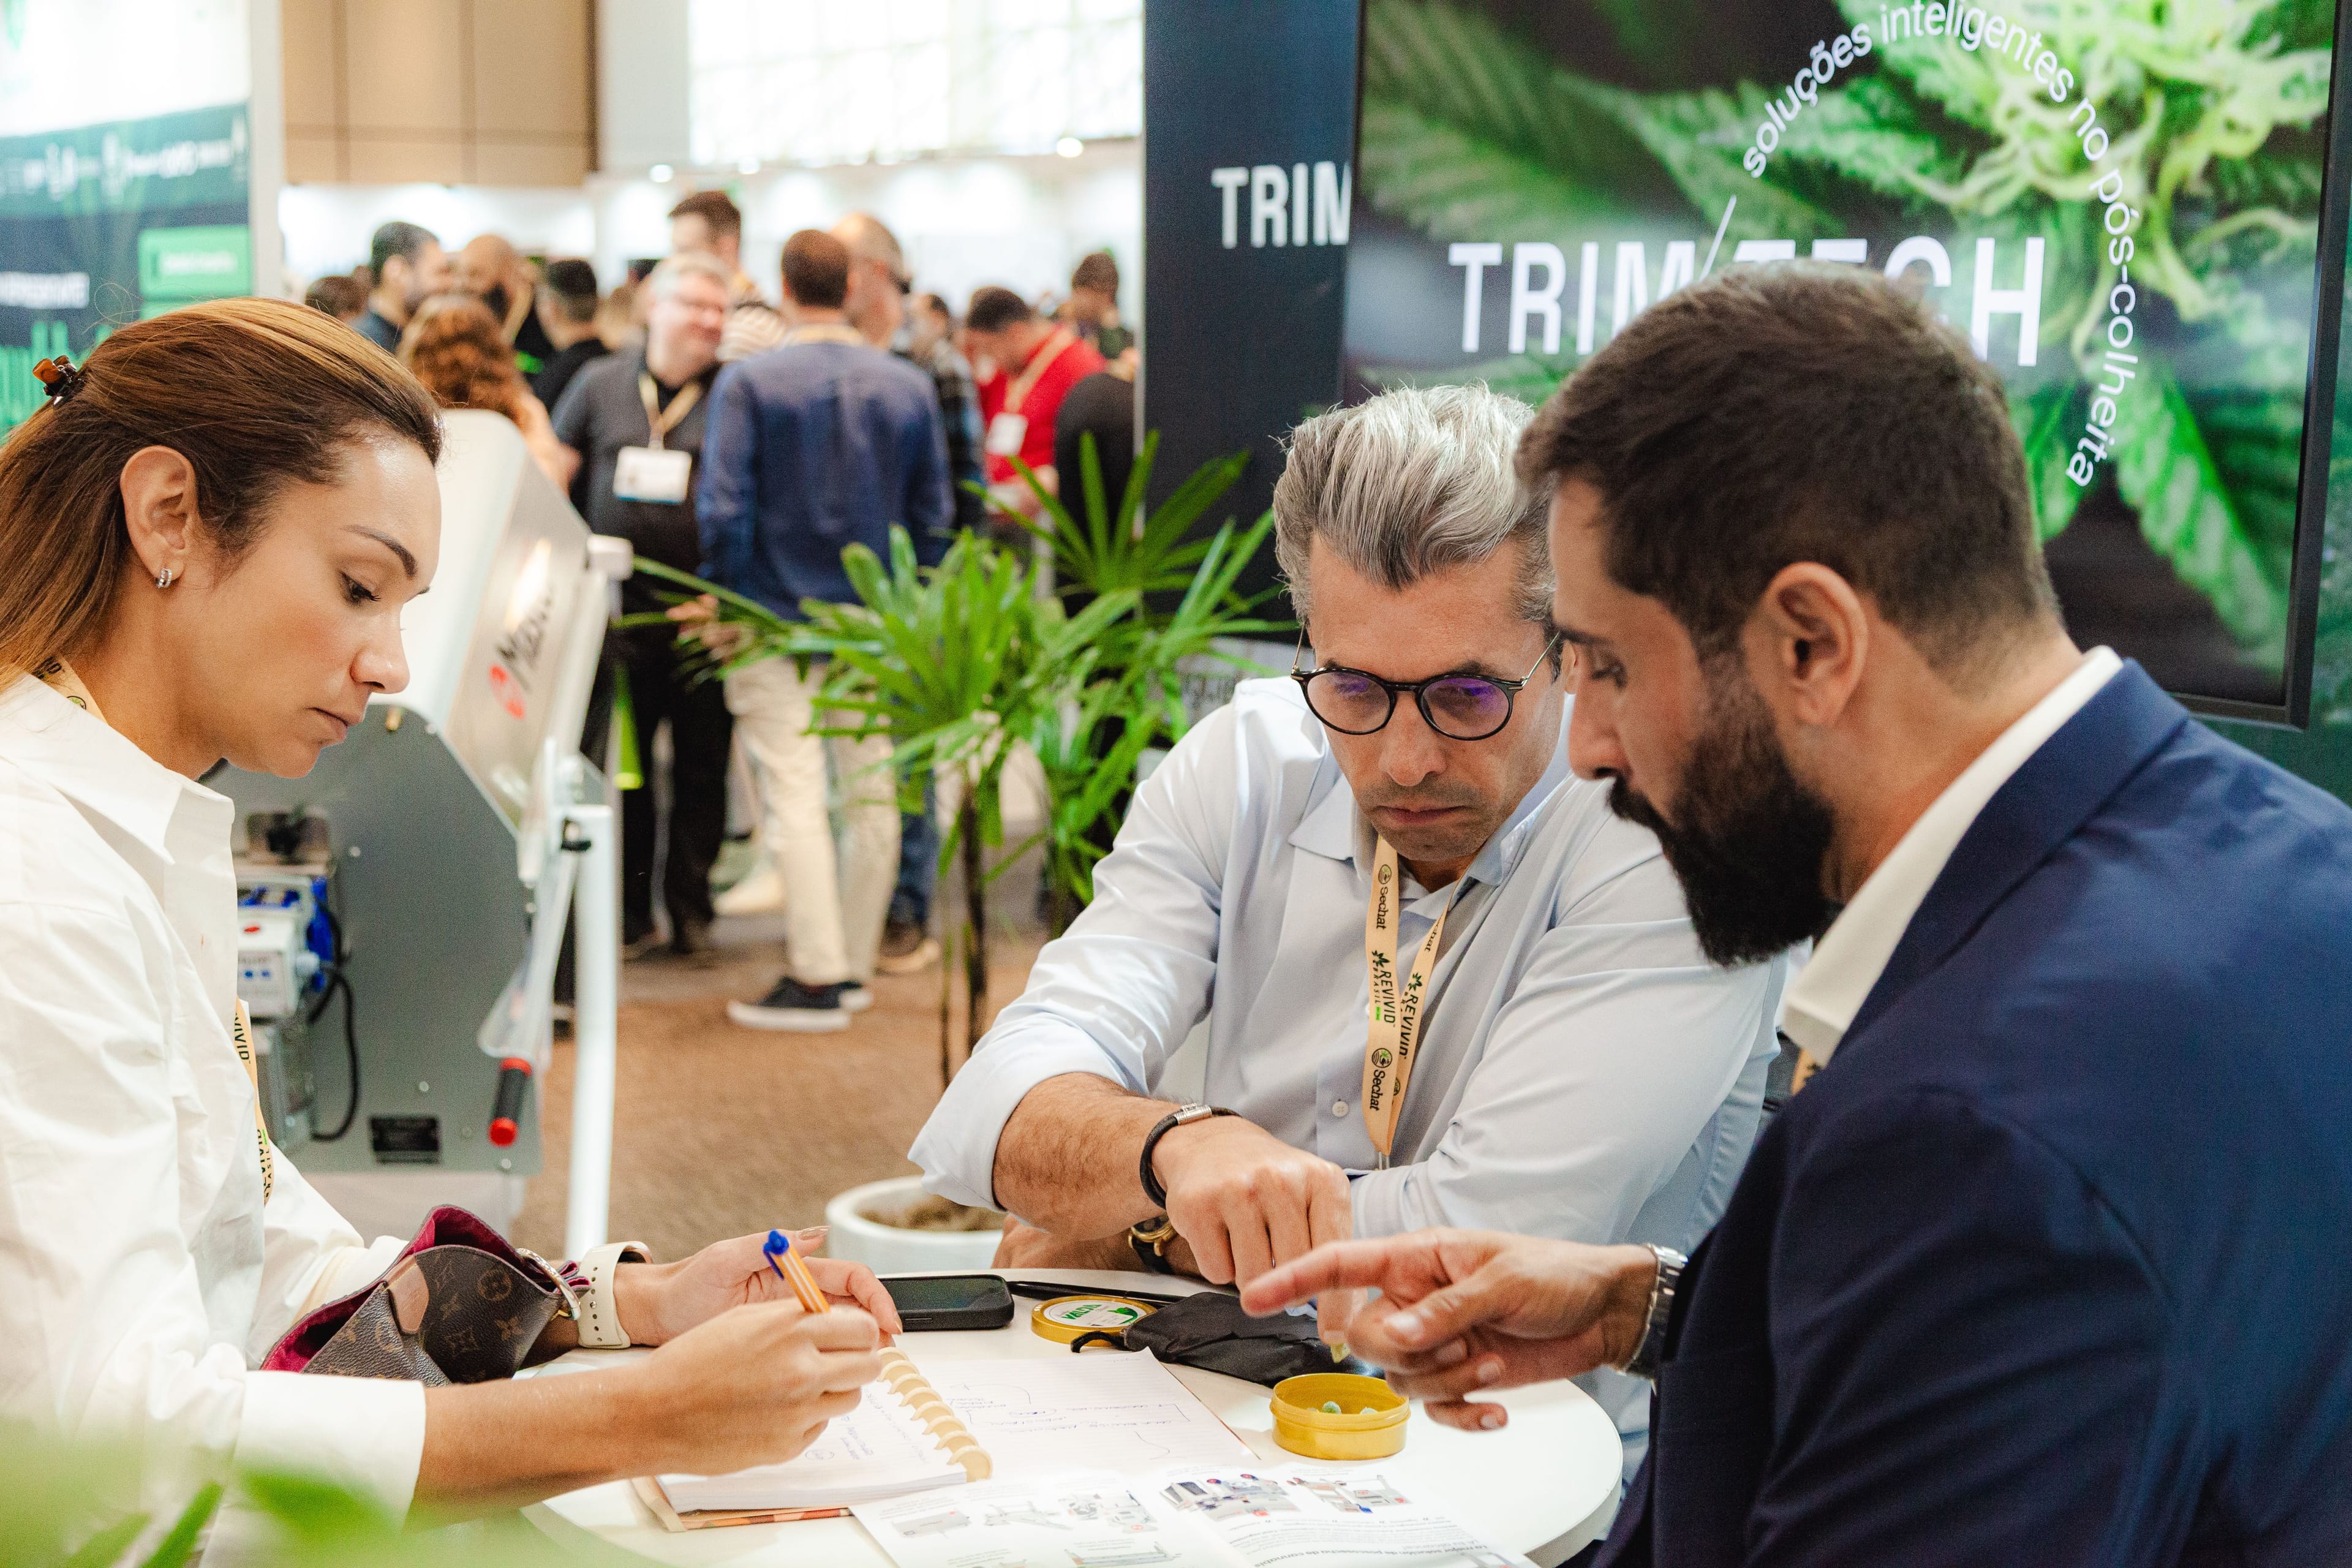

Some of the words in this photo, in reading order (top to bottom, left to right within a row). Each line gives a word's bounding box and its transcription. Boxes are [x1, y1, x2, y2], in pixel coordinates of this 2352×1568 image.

[1880, 0, 2075, 103] inteligentes
[1743, 21, 1872, 178] soluções
[2068, 97, 2109, 162] no
[2065, 168, 2139, 487] pós-colheita
[1376, 886, 1389, 930] Sechat
[1425, 922, 1439, 952] chat
[1378, 970, 1396, 1024] REVIVID
[234, 1014, 250, 1061] VIVID
[1370, 1069, 1386, 1111] Sechat
[1254, 1552, 1304, 1568] cannabis
